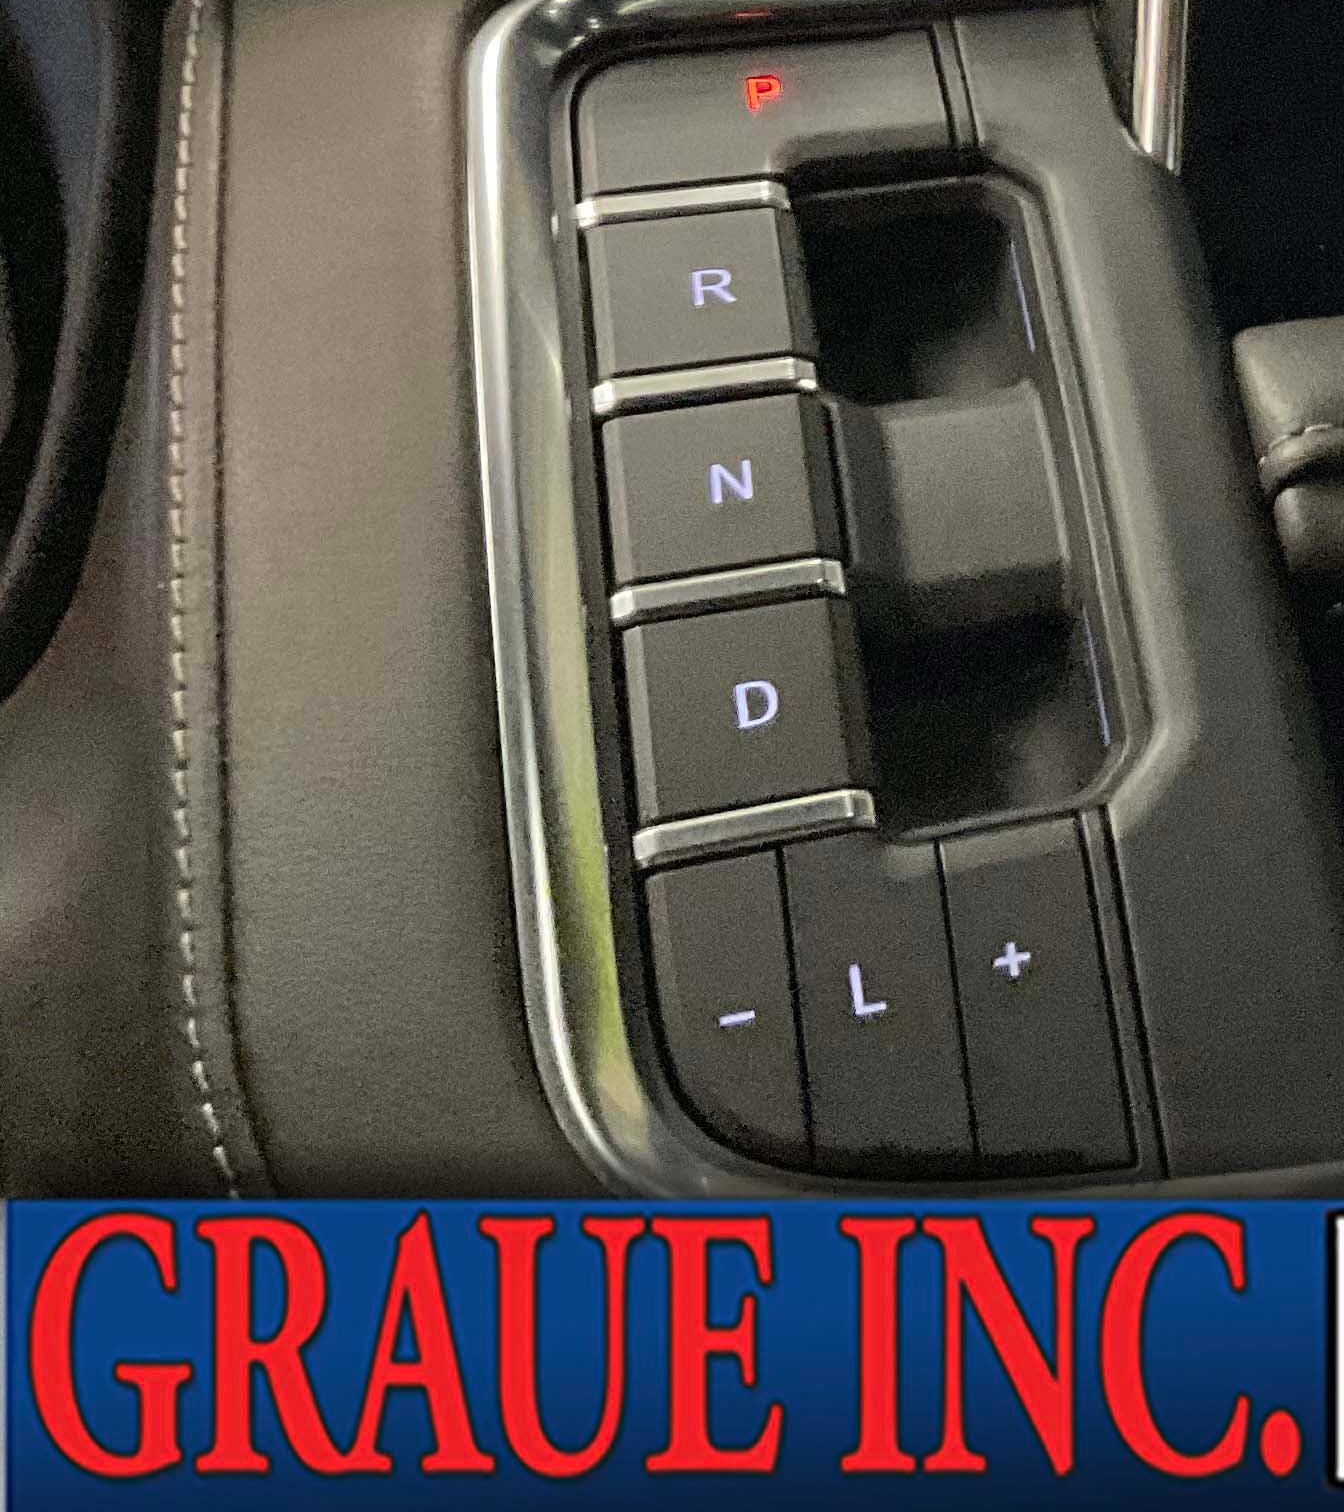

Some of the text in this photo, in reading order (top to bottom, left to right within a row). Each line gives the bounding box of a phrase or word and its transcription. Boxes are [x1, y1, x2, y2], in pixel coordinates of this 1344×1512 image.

[744, 74, 783, 112] P
[691, 268, 738, 307] R
[709, 459, 754, 505] N
[733, 680, 778, 729] D
[849, 964, 887, 1016] L
